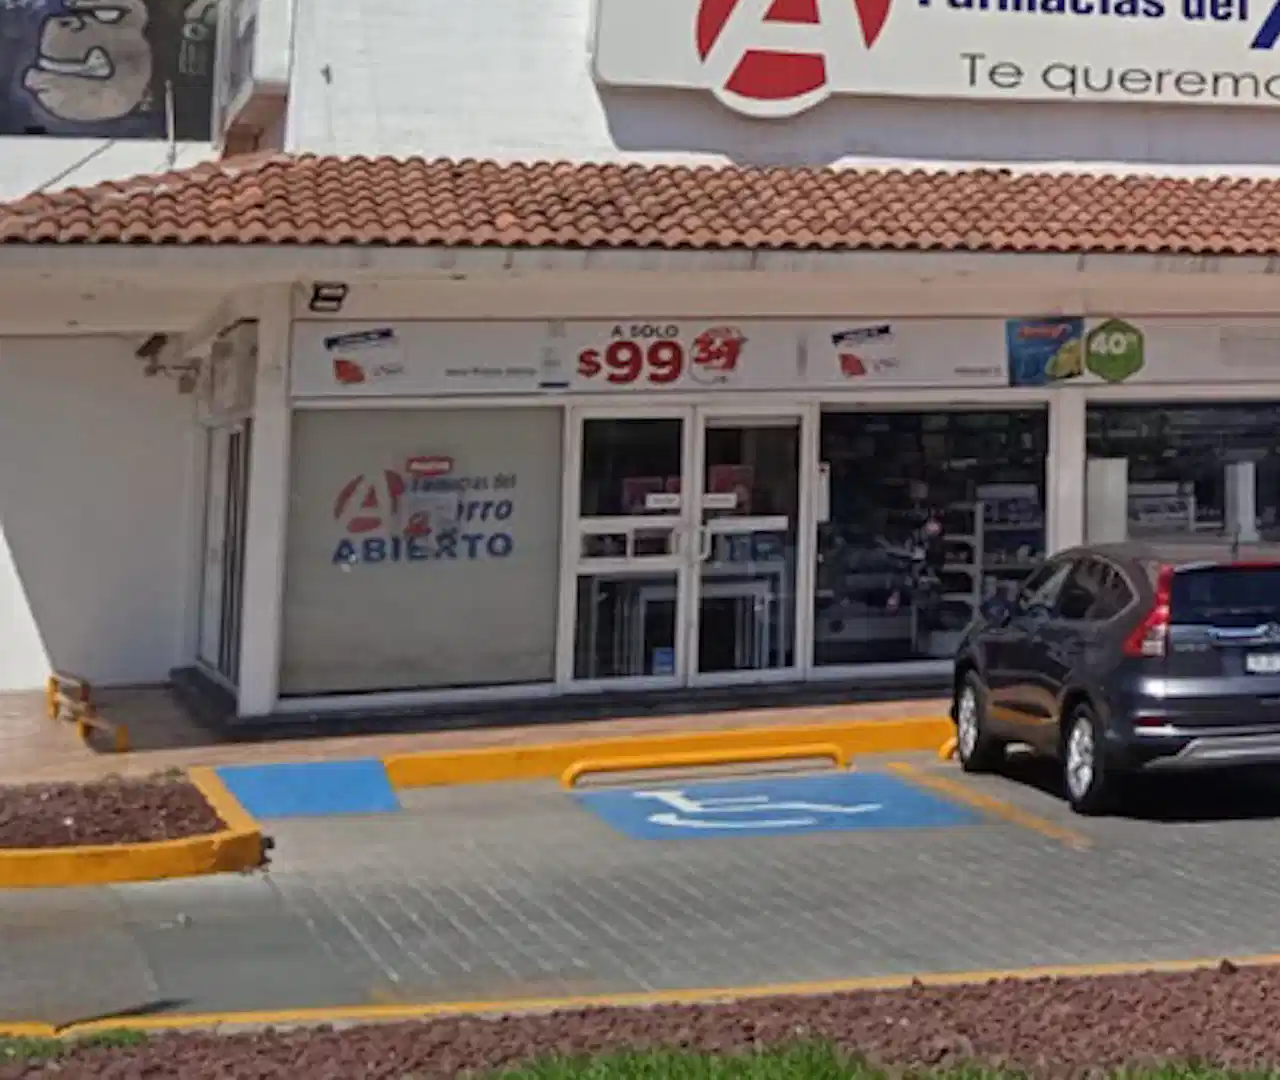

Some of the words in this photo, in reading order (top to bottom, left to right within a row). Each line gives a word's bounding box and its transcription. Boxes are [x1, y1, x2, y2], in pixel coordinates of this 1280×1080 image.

[961, 53, 1023, 89] Te
[629, 324, 680, 338] SOLO
[576, 339, 685, 384] $99
[332, 531, 513, 565] ABIERTO
